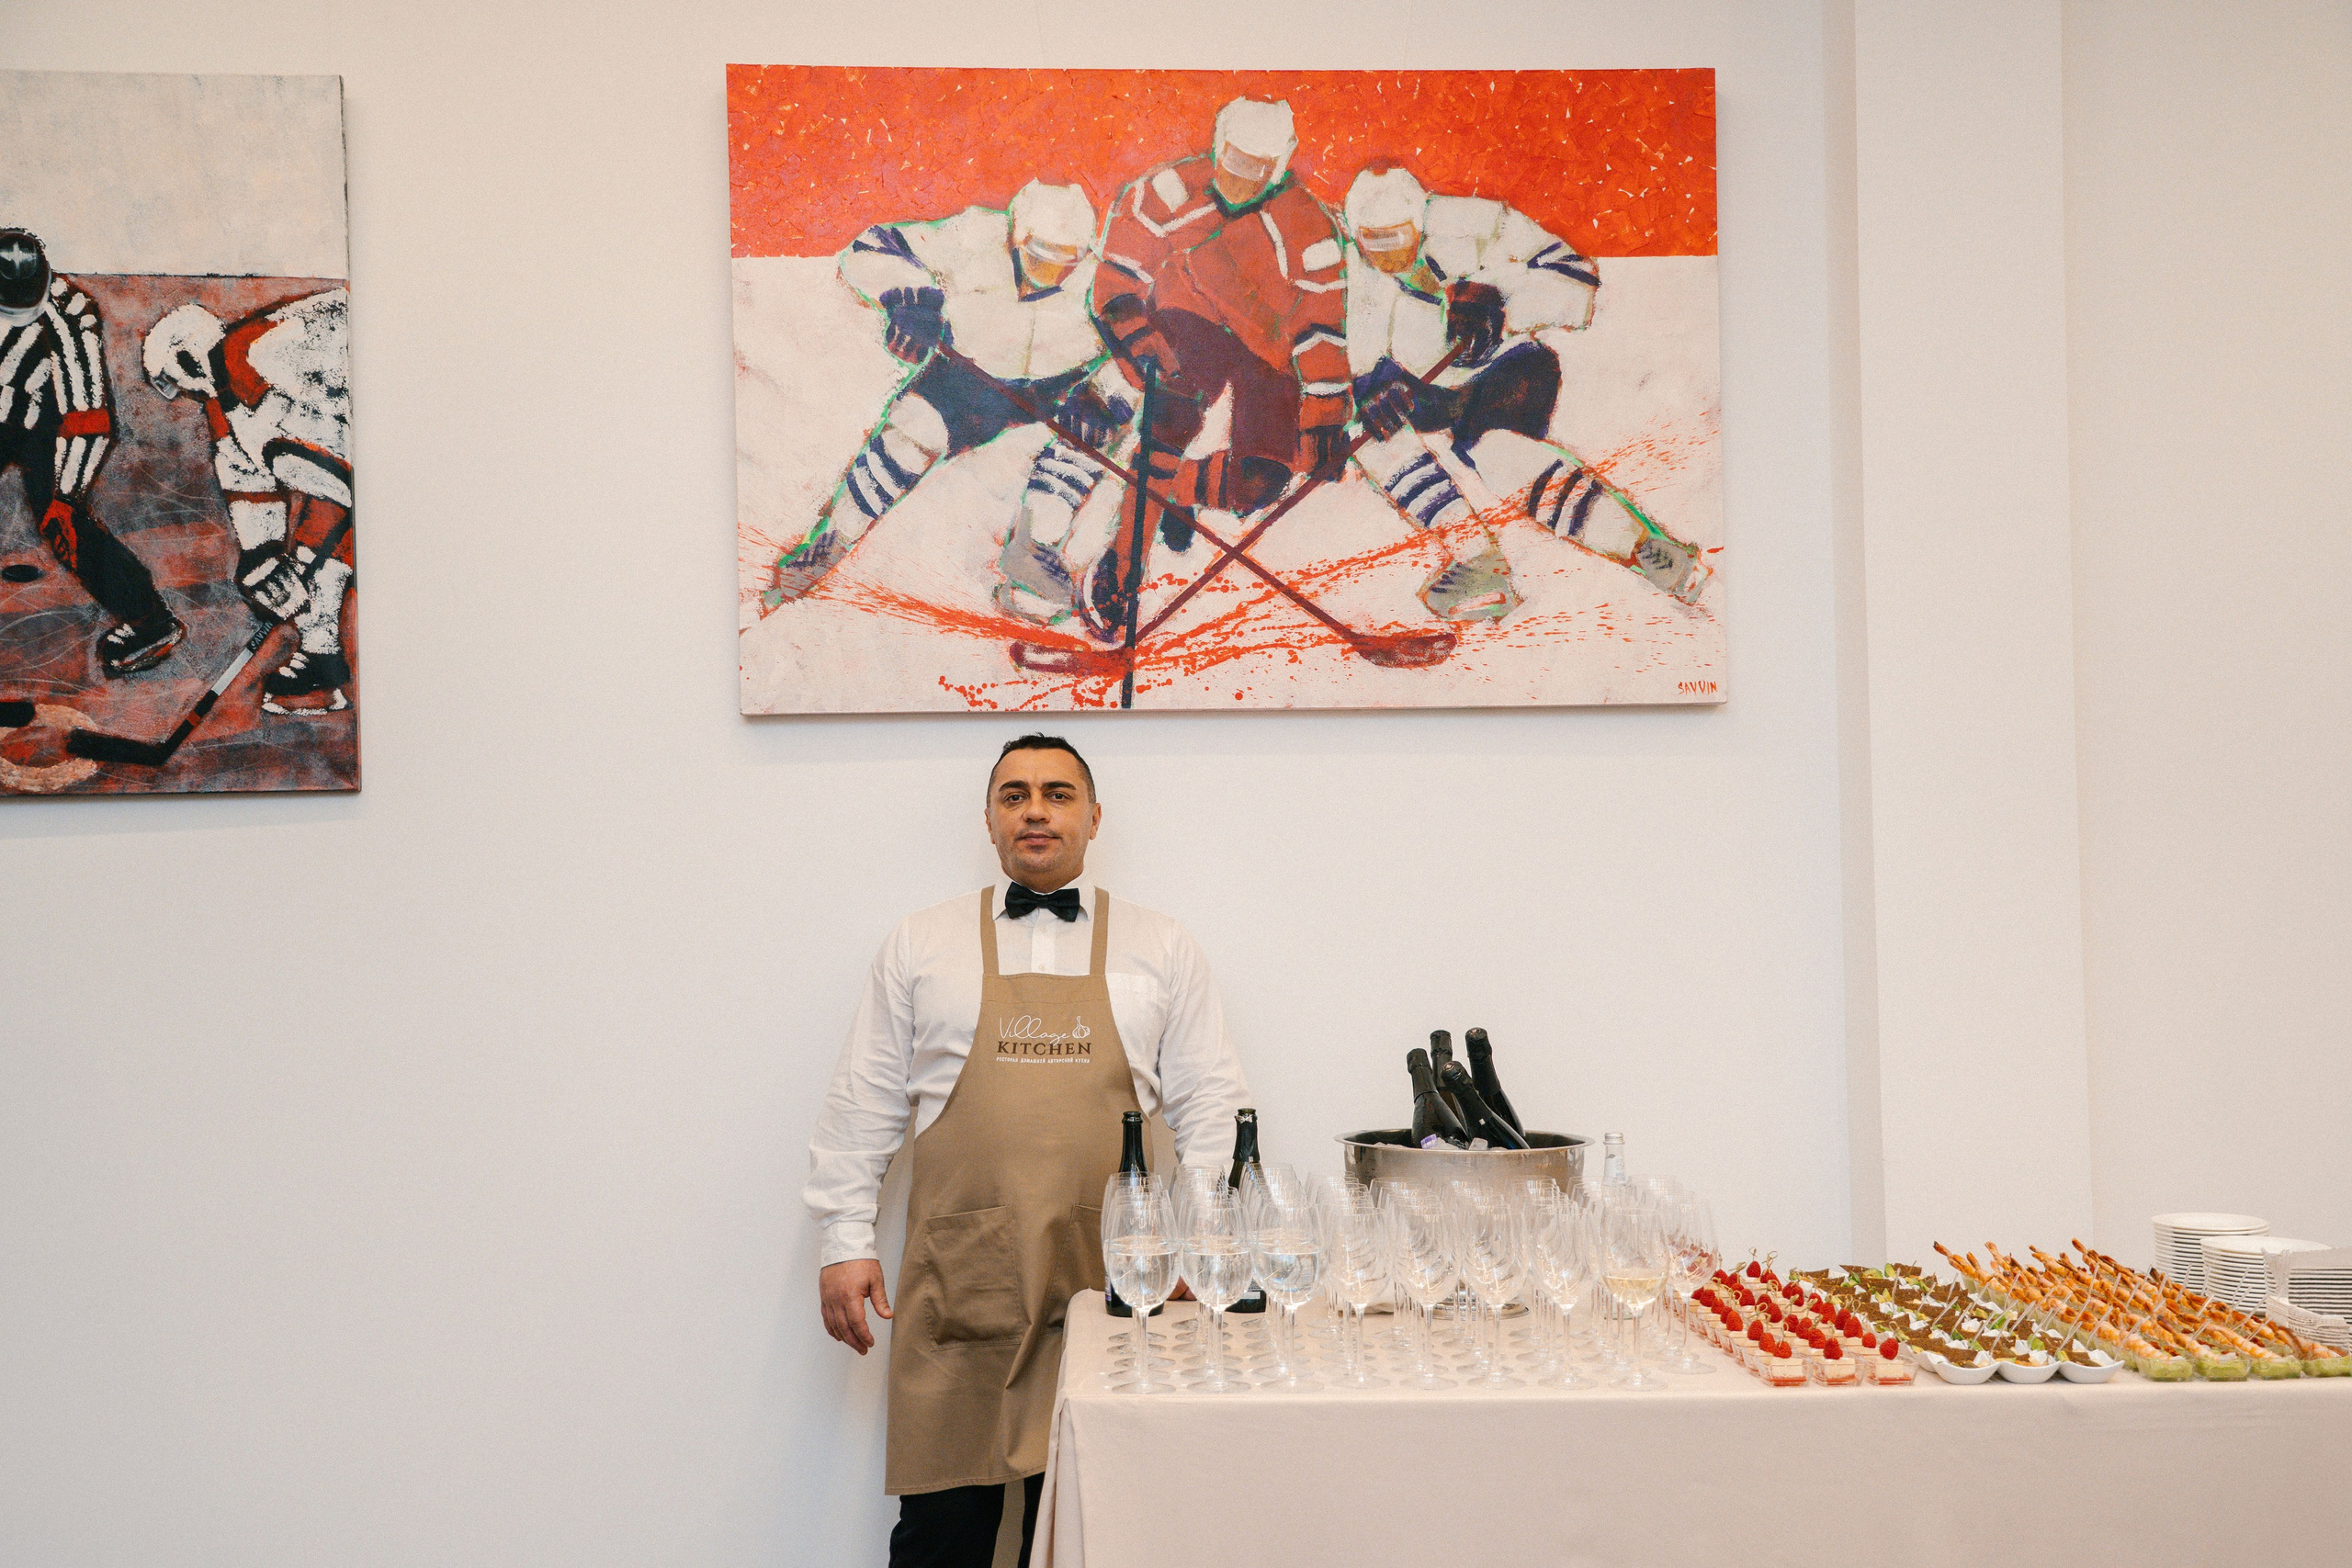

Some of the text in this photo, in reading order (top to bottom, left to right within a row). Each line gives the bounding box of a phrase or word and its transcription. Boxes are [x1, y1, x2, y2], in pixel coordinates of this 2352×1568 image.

[1678, 680, 1717, 695] SAVVIN
[1000, 1015, 1070, 1045] Village
[998, 1041, 1091, 1055] KITCHEN
